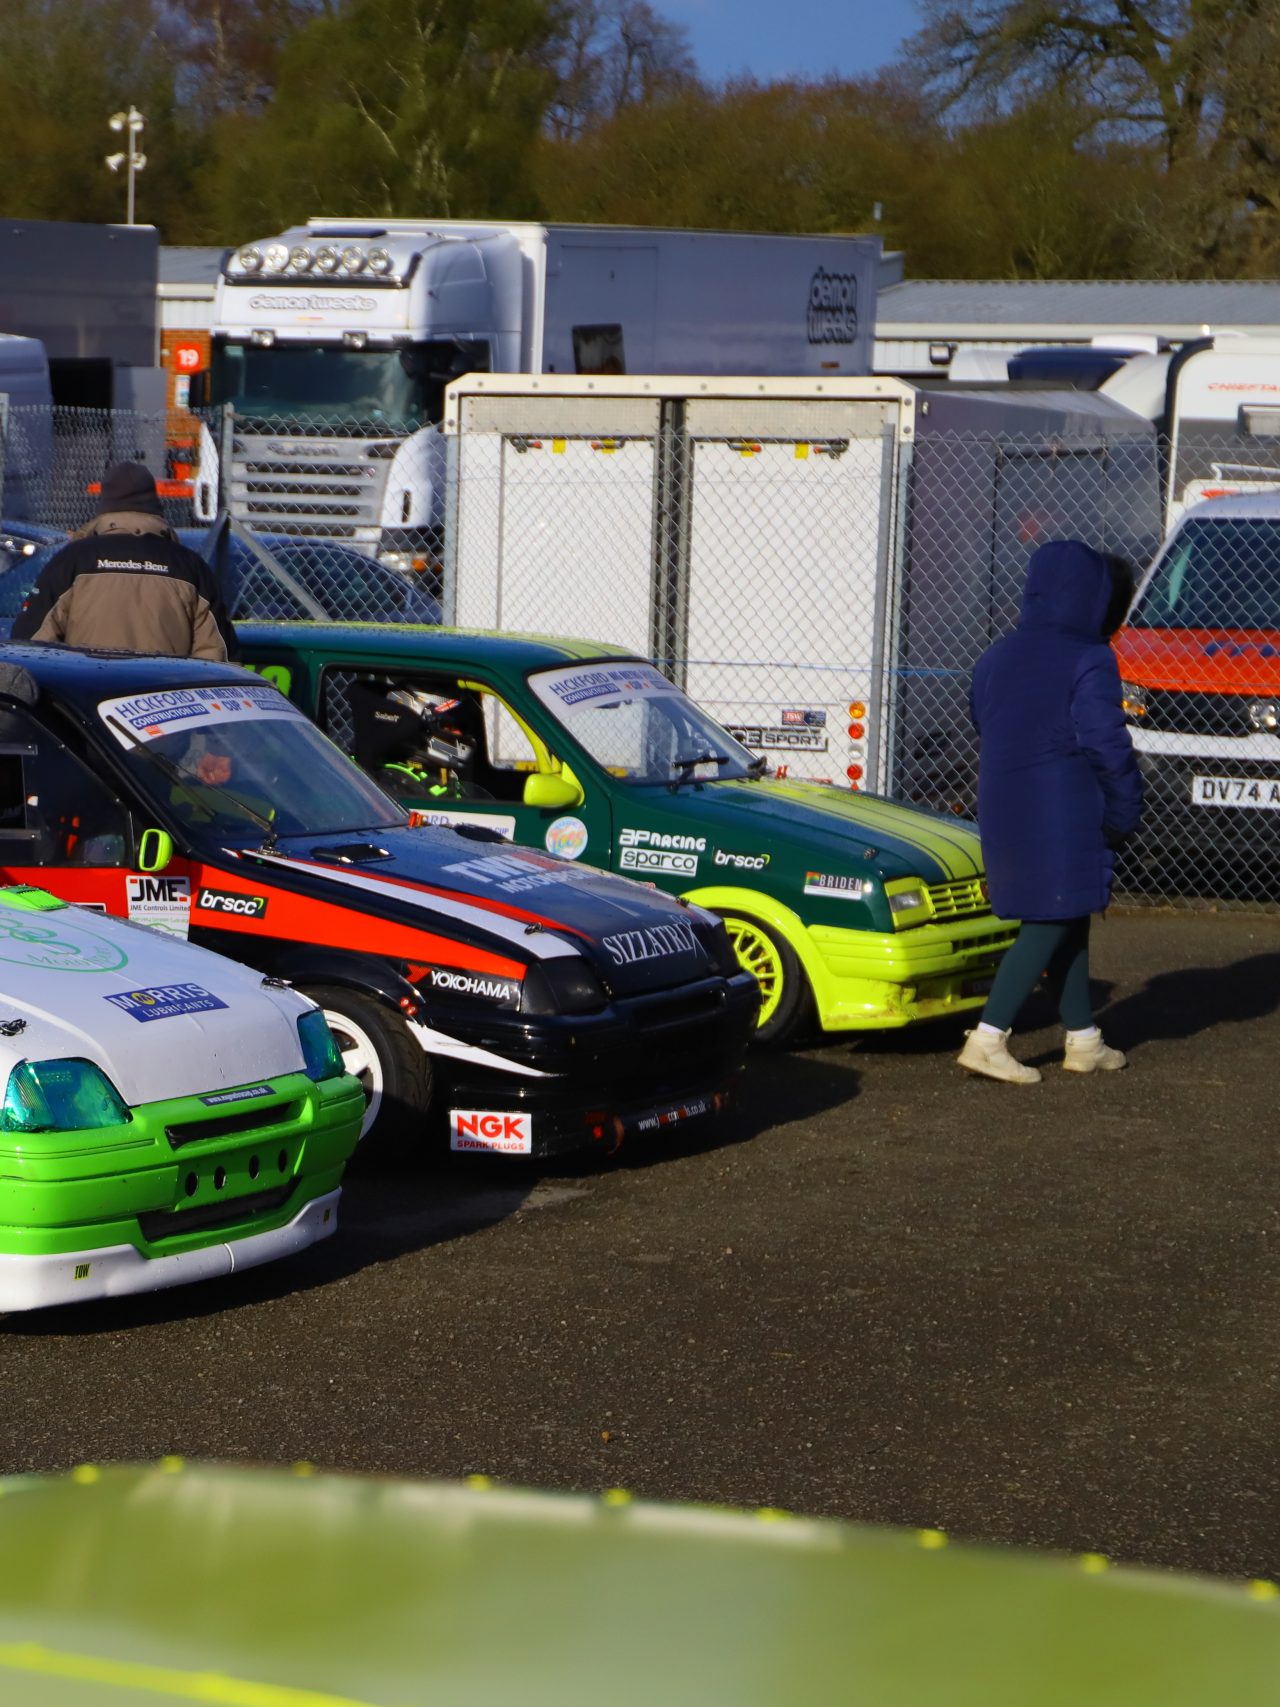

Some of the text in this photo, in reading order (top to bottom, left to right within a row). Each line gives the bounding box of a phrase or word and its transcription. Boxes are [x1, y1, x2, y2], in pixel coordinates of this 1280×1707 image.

[177, 349, 199, 365] 19
[97, 559, 169, 572] Mercedes-Benz
[548, 671, 609, 696] HICKFORD
[115, 690, 197, 719] HICKFORD
[131, 706, 192, 729] CONSTRUCTION
[765, 733, 821, 746] SPORT
[1202, 780, 1261, 802] DV74
[650, 832, 707, 851] RACING
[623, 850, 697, 872] sparco
[714, 849, 766, 869] brscc
[131, 878, 187, 902] JME
[819, 873, 863, 891] BRIDEN
[130, 904, 143, 912] JME
[143, 904, 168, 912] Controls
[200, 890, 258, 915] brscc
[431, 969, 511, 1000] YOKOHAMA
[107, 984, 210, 1010] MORRIS
[142, 1000, 215, 1018] LUBRICANTS
[456, 1113, 525, 1140] NGK
[457, 1140, 525, 1151] SPARK PLUGS
[74, 1263, 90, 1280] TOW
